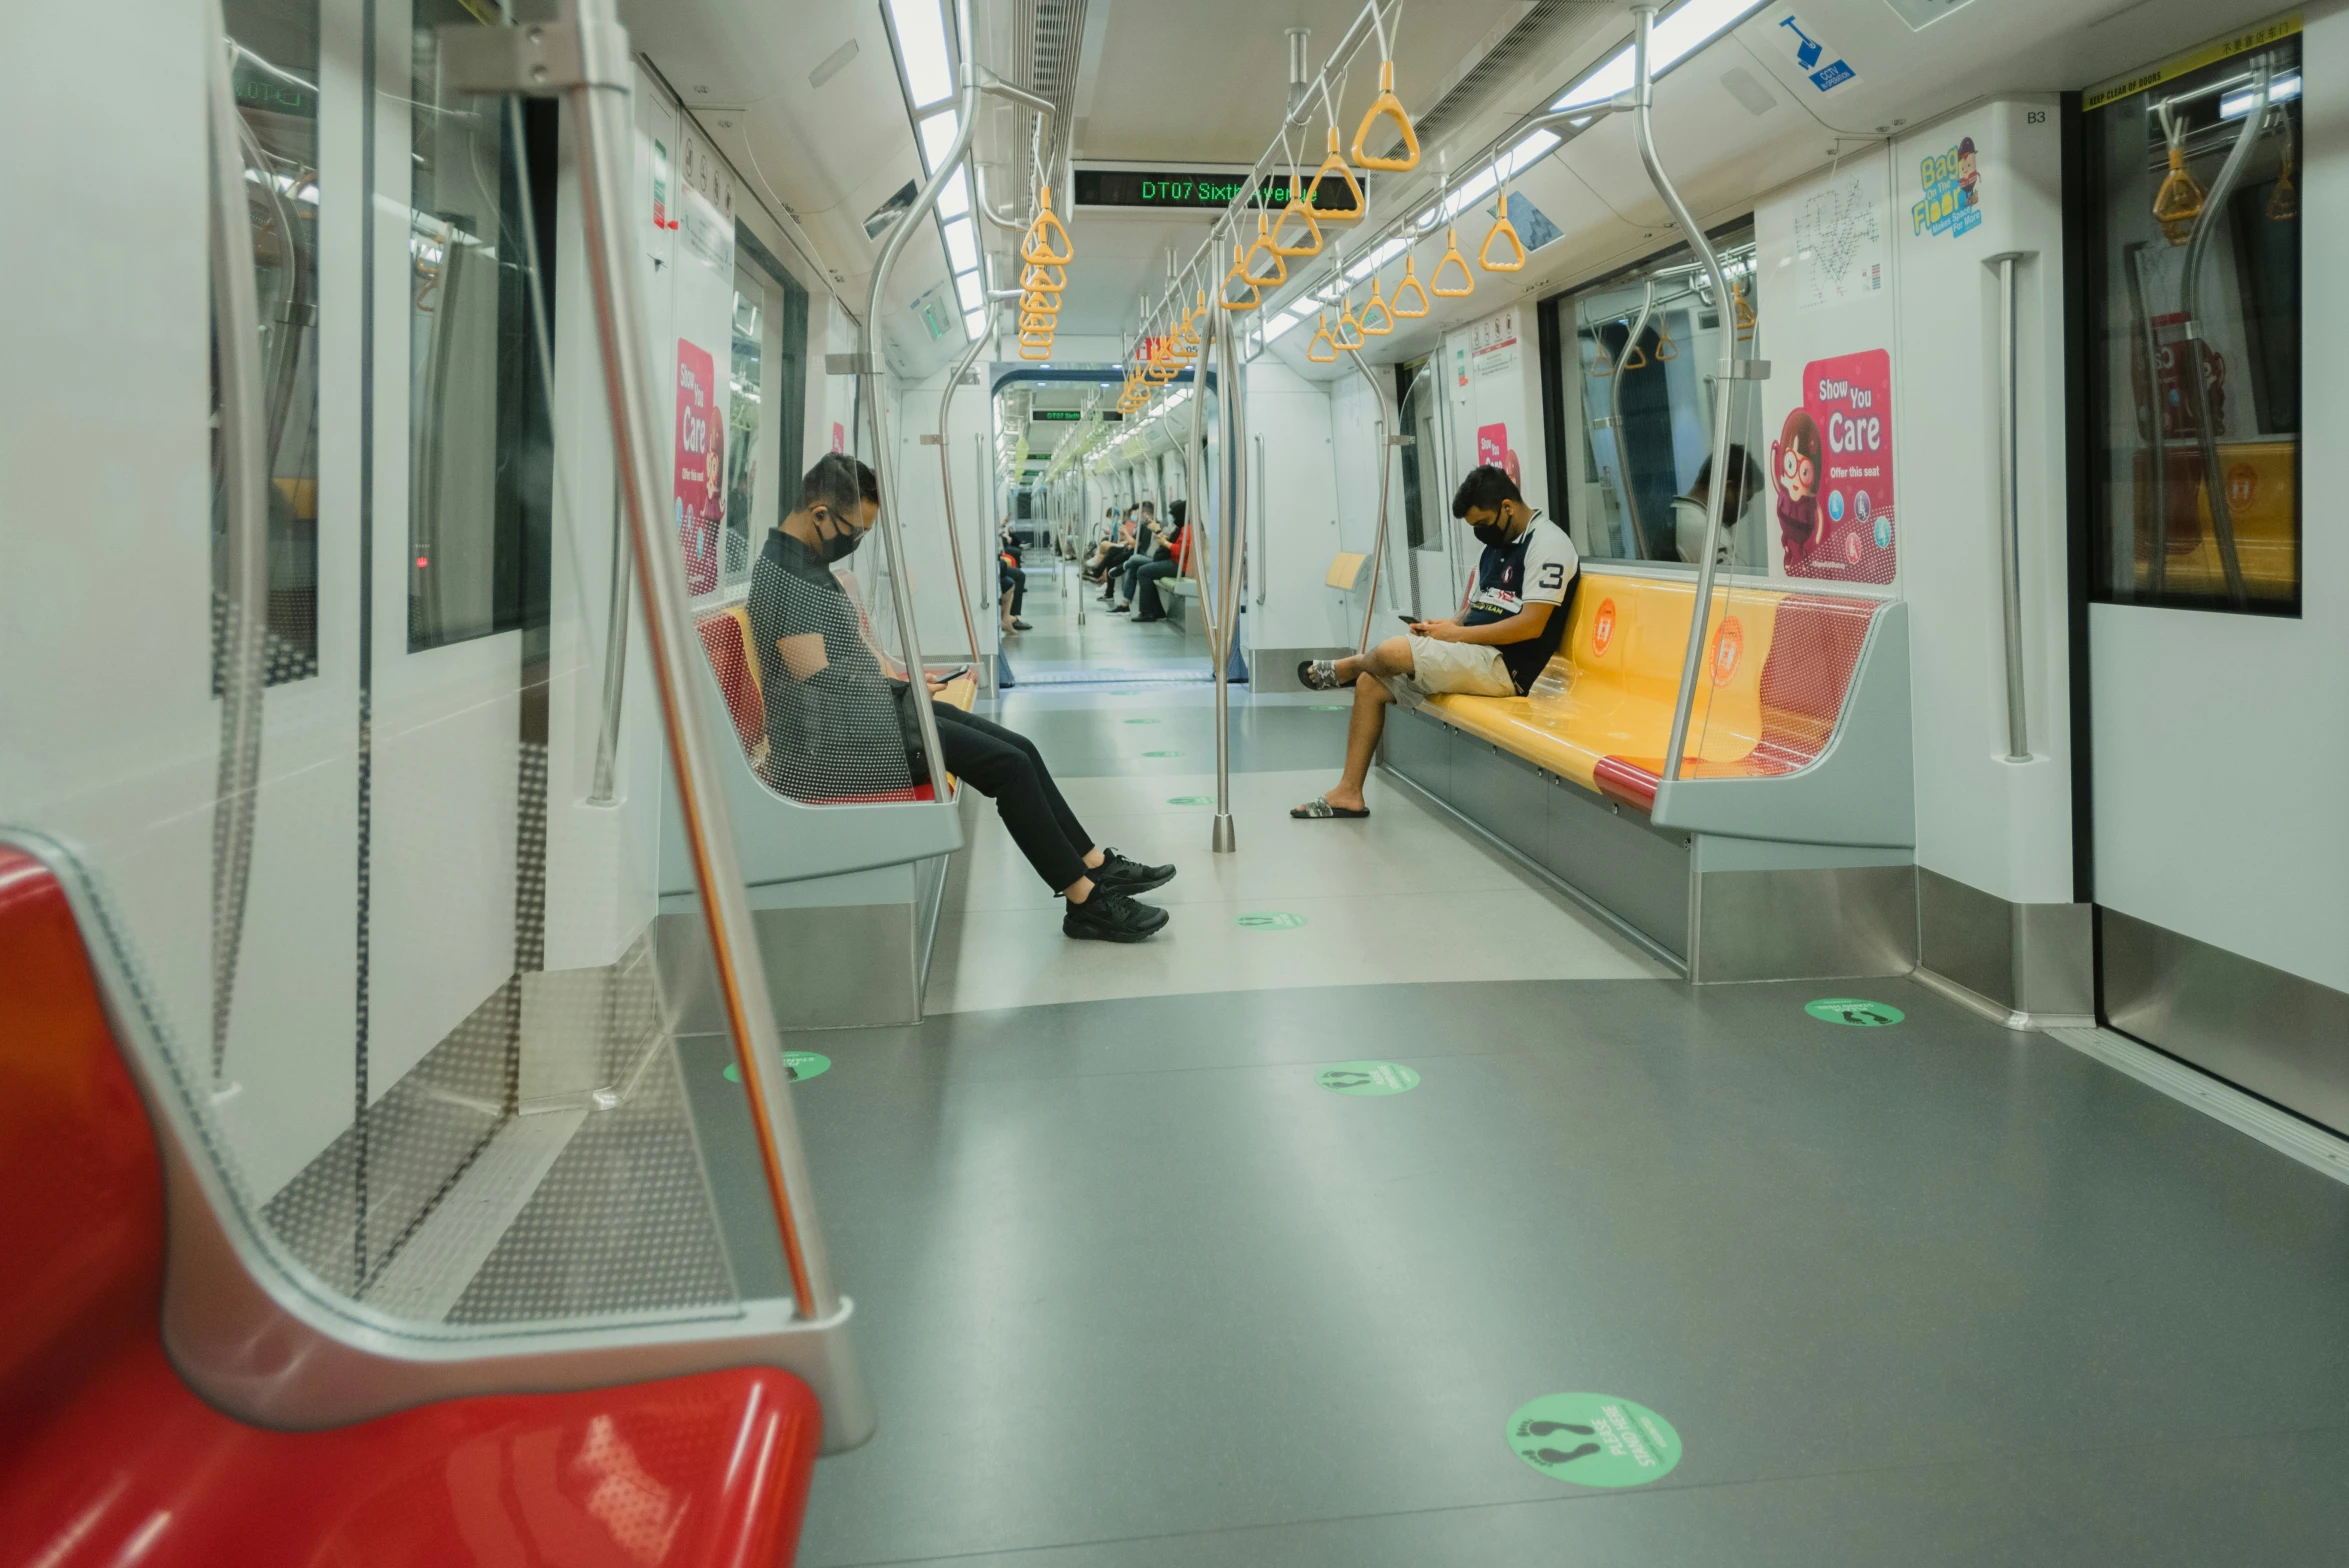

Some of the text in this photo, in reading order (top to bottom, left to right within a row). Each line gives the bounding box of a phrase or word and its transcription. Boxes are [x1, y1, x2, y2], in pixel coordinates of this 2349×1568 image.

[1820, 66, 1839, 81] CCTV
[1824, 71, 1851, 88] OPERATION
[2089, 71, 2162, 106] KEEP CLEAR OF DOORS
[2027, 111, 2046, 124] B3
[1921, 147, 1959, 190] Bag
[1142, 181, 1194, 200] DT07
[1926, 179, 1951, 201] On The
[1913, 187, 1961, 234] Floor
[1932, 217, 1951, 234] Makes
[1952, 205, 1971, 221] Space
[1953, 221, 1963, 233] For
[1964, 211, 1980, 227] More
[681, 362, 695, 390] Show
[695, 383, 704, 408] You
[1819, 378, 1848, 401] Show
[1850, 387, 1872, 409] You
[683, 405, 706, 454] Care
[1829, 412, 1880, 453] Care
[1830, 465, 1880, 479] Offer this seat
[1539, 563, 1564, 590] 3
[1485, 603, 1504, 615] TEAM
[1600, 1404, 1630, 1431] HERE
[1590, 1418, 1628, 1456] PLEASE
[1621, 1431, 1657, 1467] STAND
